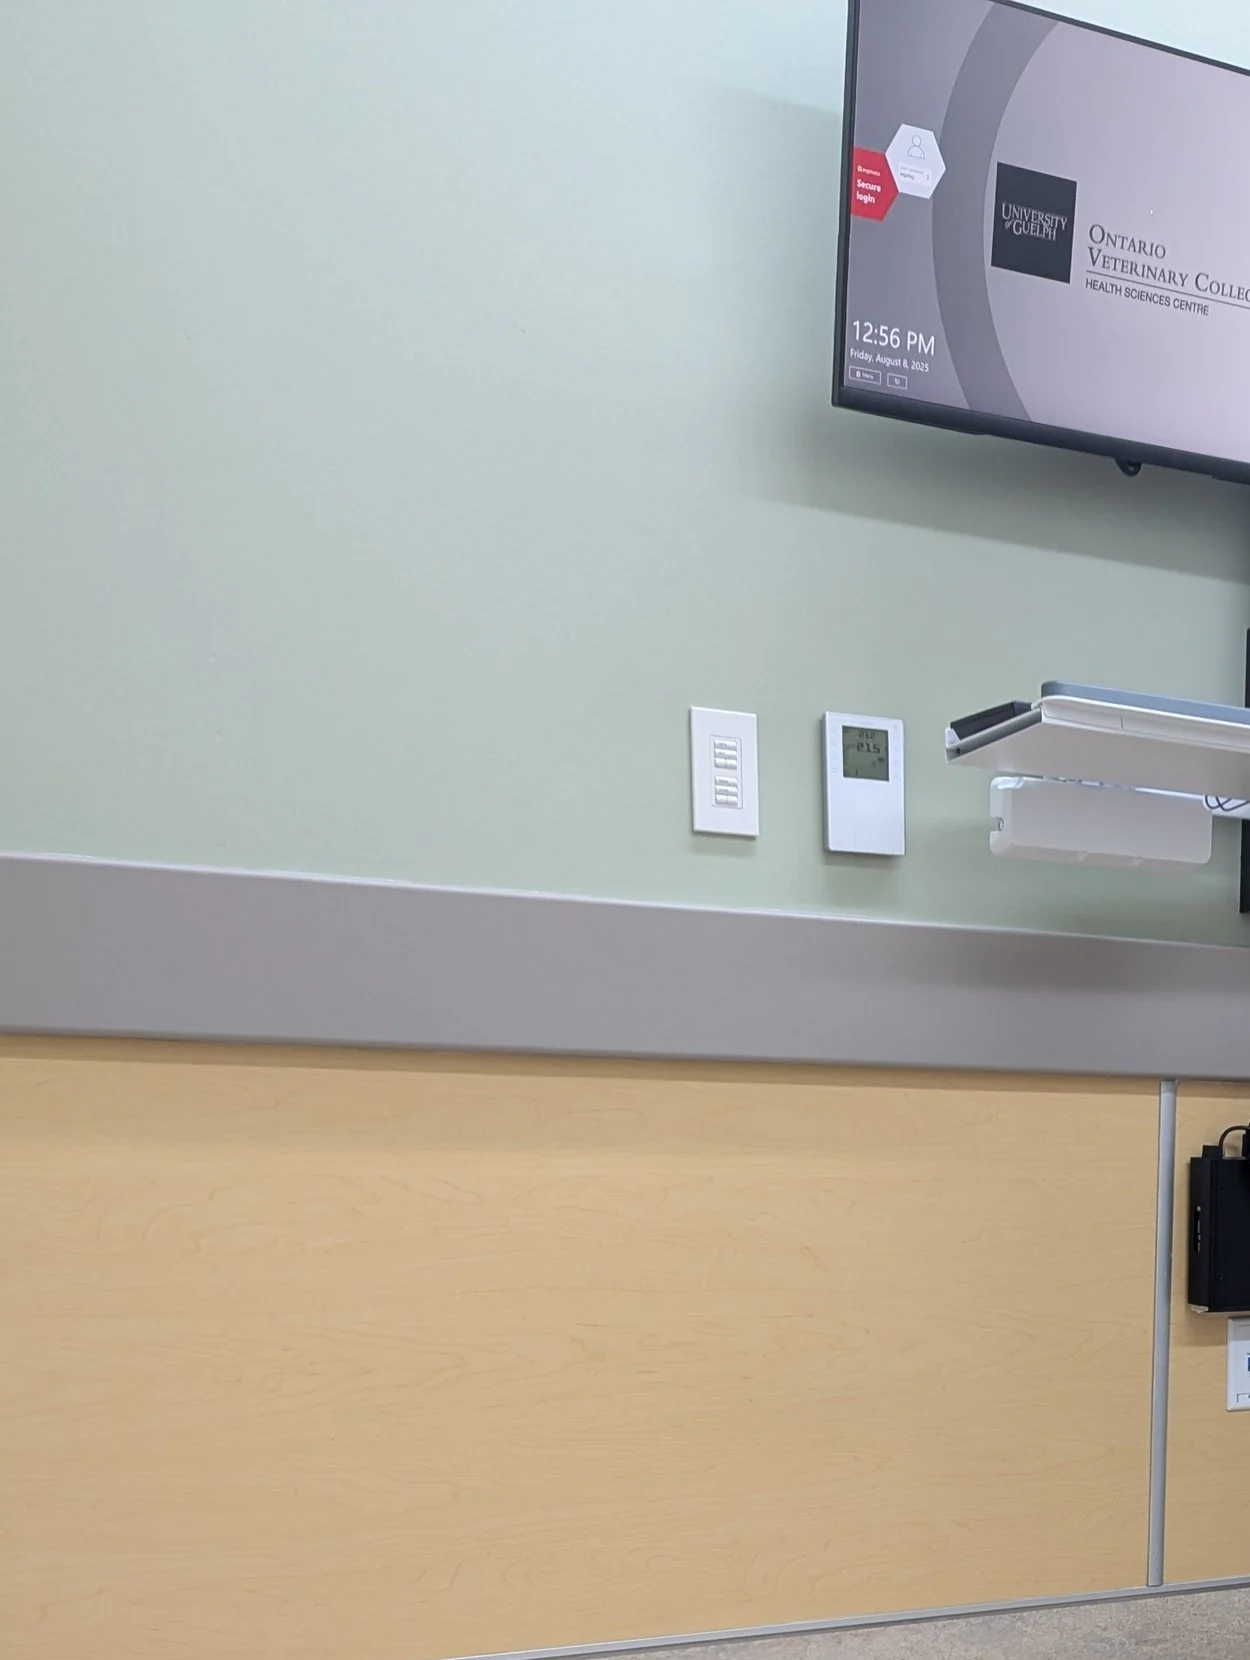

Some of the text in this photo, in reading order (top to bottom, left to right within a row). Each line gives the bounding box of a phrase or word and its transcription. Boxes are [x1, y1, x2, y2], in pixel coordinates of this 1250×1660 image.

[856, 179, 882, 193] Secure
[856, 191, 876, 204] login
[1001, 202, 1069, 231] UNIVERSITY
[1004, 219, 1057, 242] of GUELPH
[1088, 223, 1167, 260] ONTARIO
[1087, 246, 1189, 288] VETERINARY
[1085, 278, 1209, 316] HEALTH SCIENCES CENTRE
[853, 320, 935, 357] 12:56 PM
[850, 347, 930, 373] Friday, August 8, 2025
